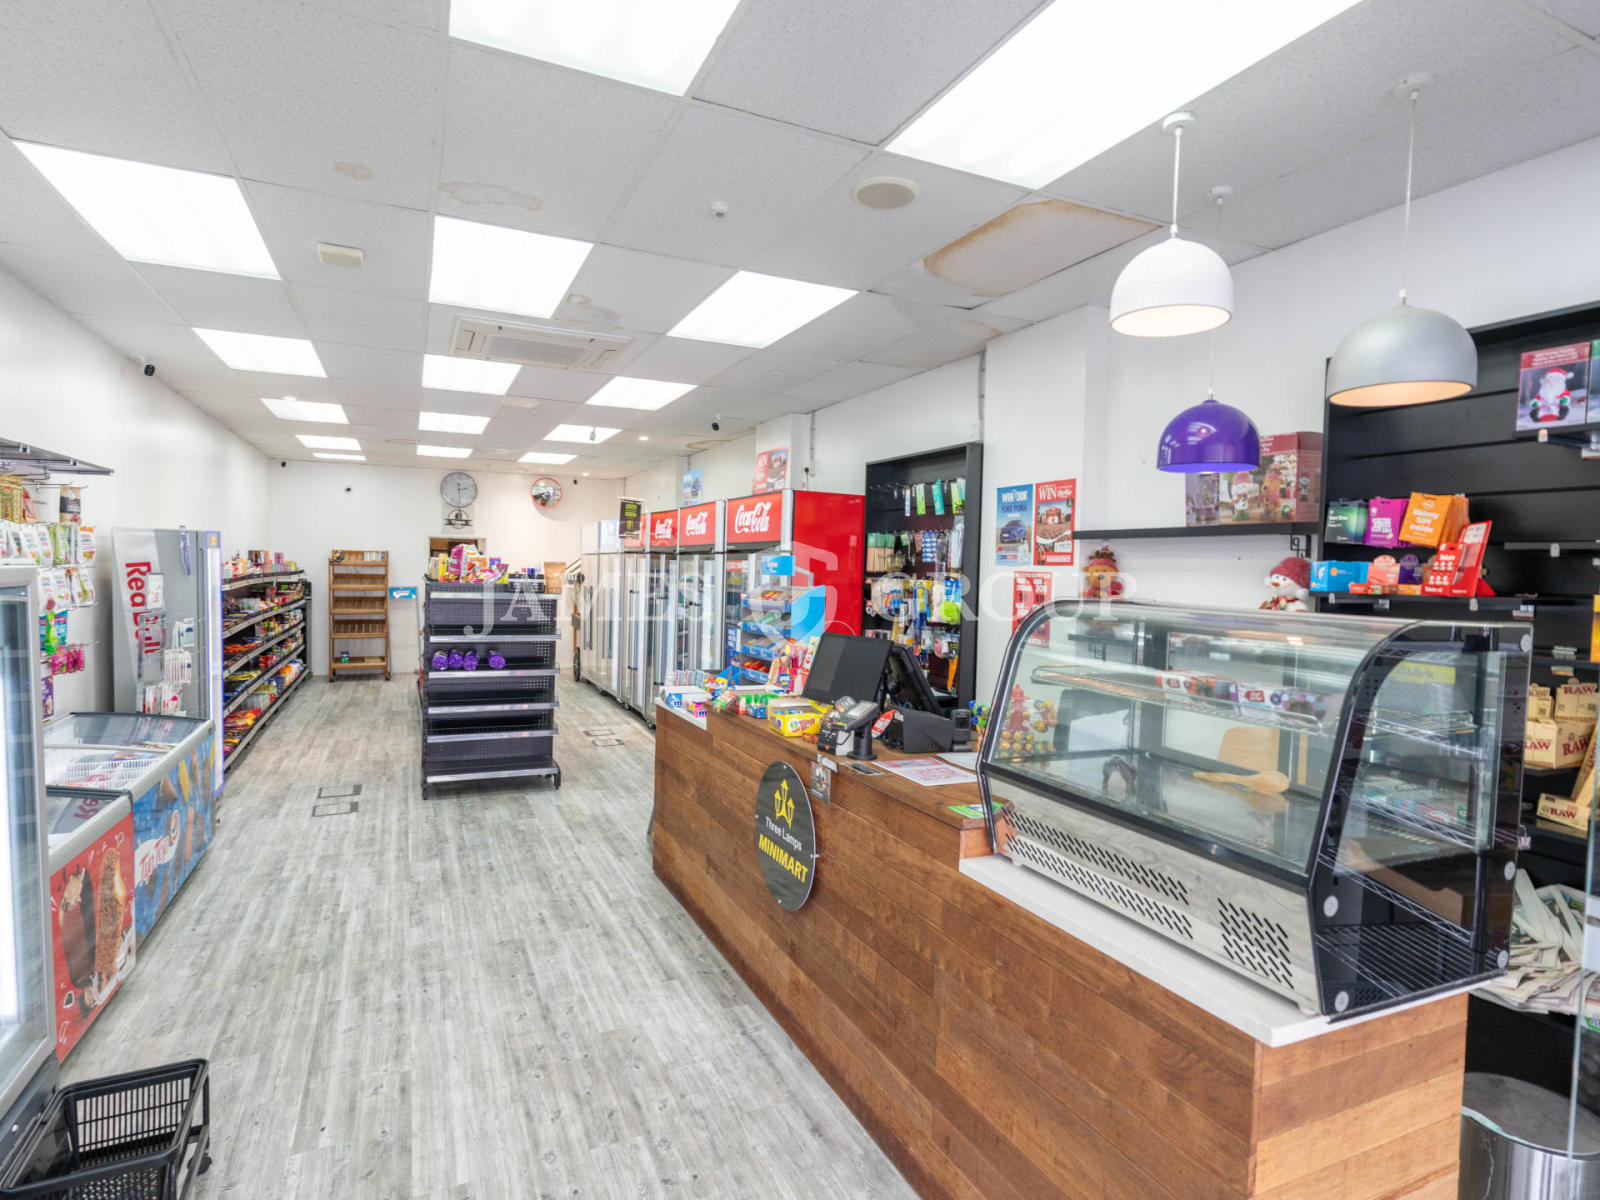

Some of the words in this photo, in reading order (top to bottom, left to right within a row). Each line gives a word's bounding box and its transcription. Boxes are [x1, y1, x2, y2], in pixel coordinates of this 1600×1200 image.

[1039, 486, 1057, 500] WIN
[735, 501, 772, 534] Coca-Cola
[1564, 685, 1594, 695] RAW
[1550, 807, 1577, 820] RAW
[765, 815, 782, 837] Three
[782, 827, 802, 851] Lamps
[759, 833, 808, 884] MINIMART
